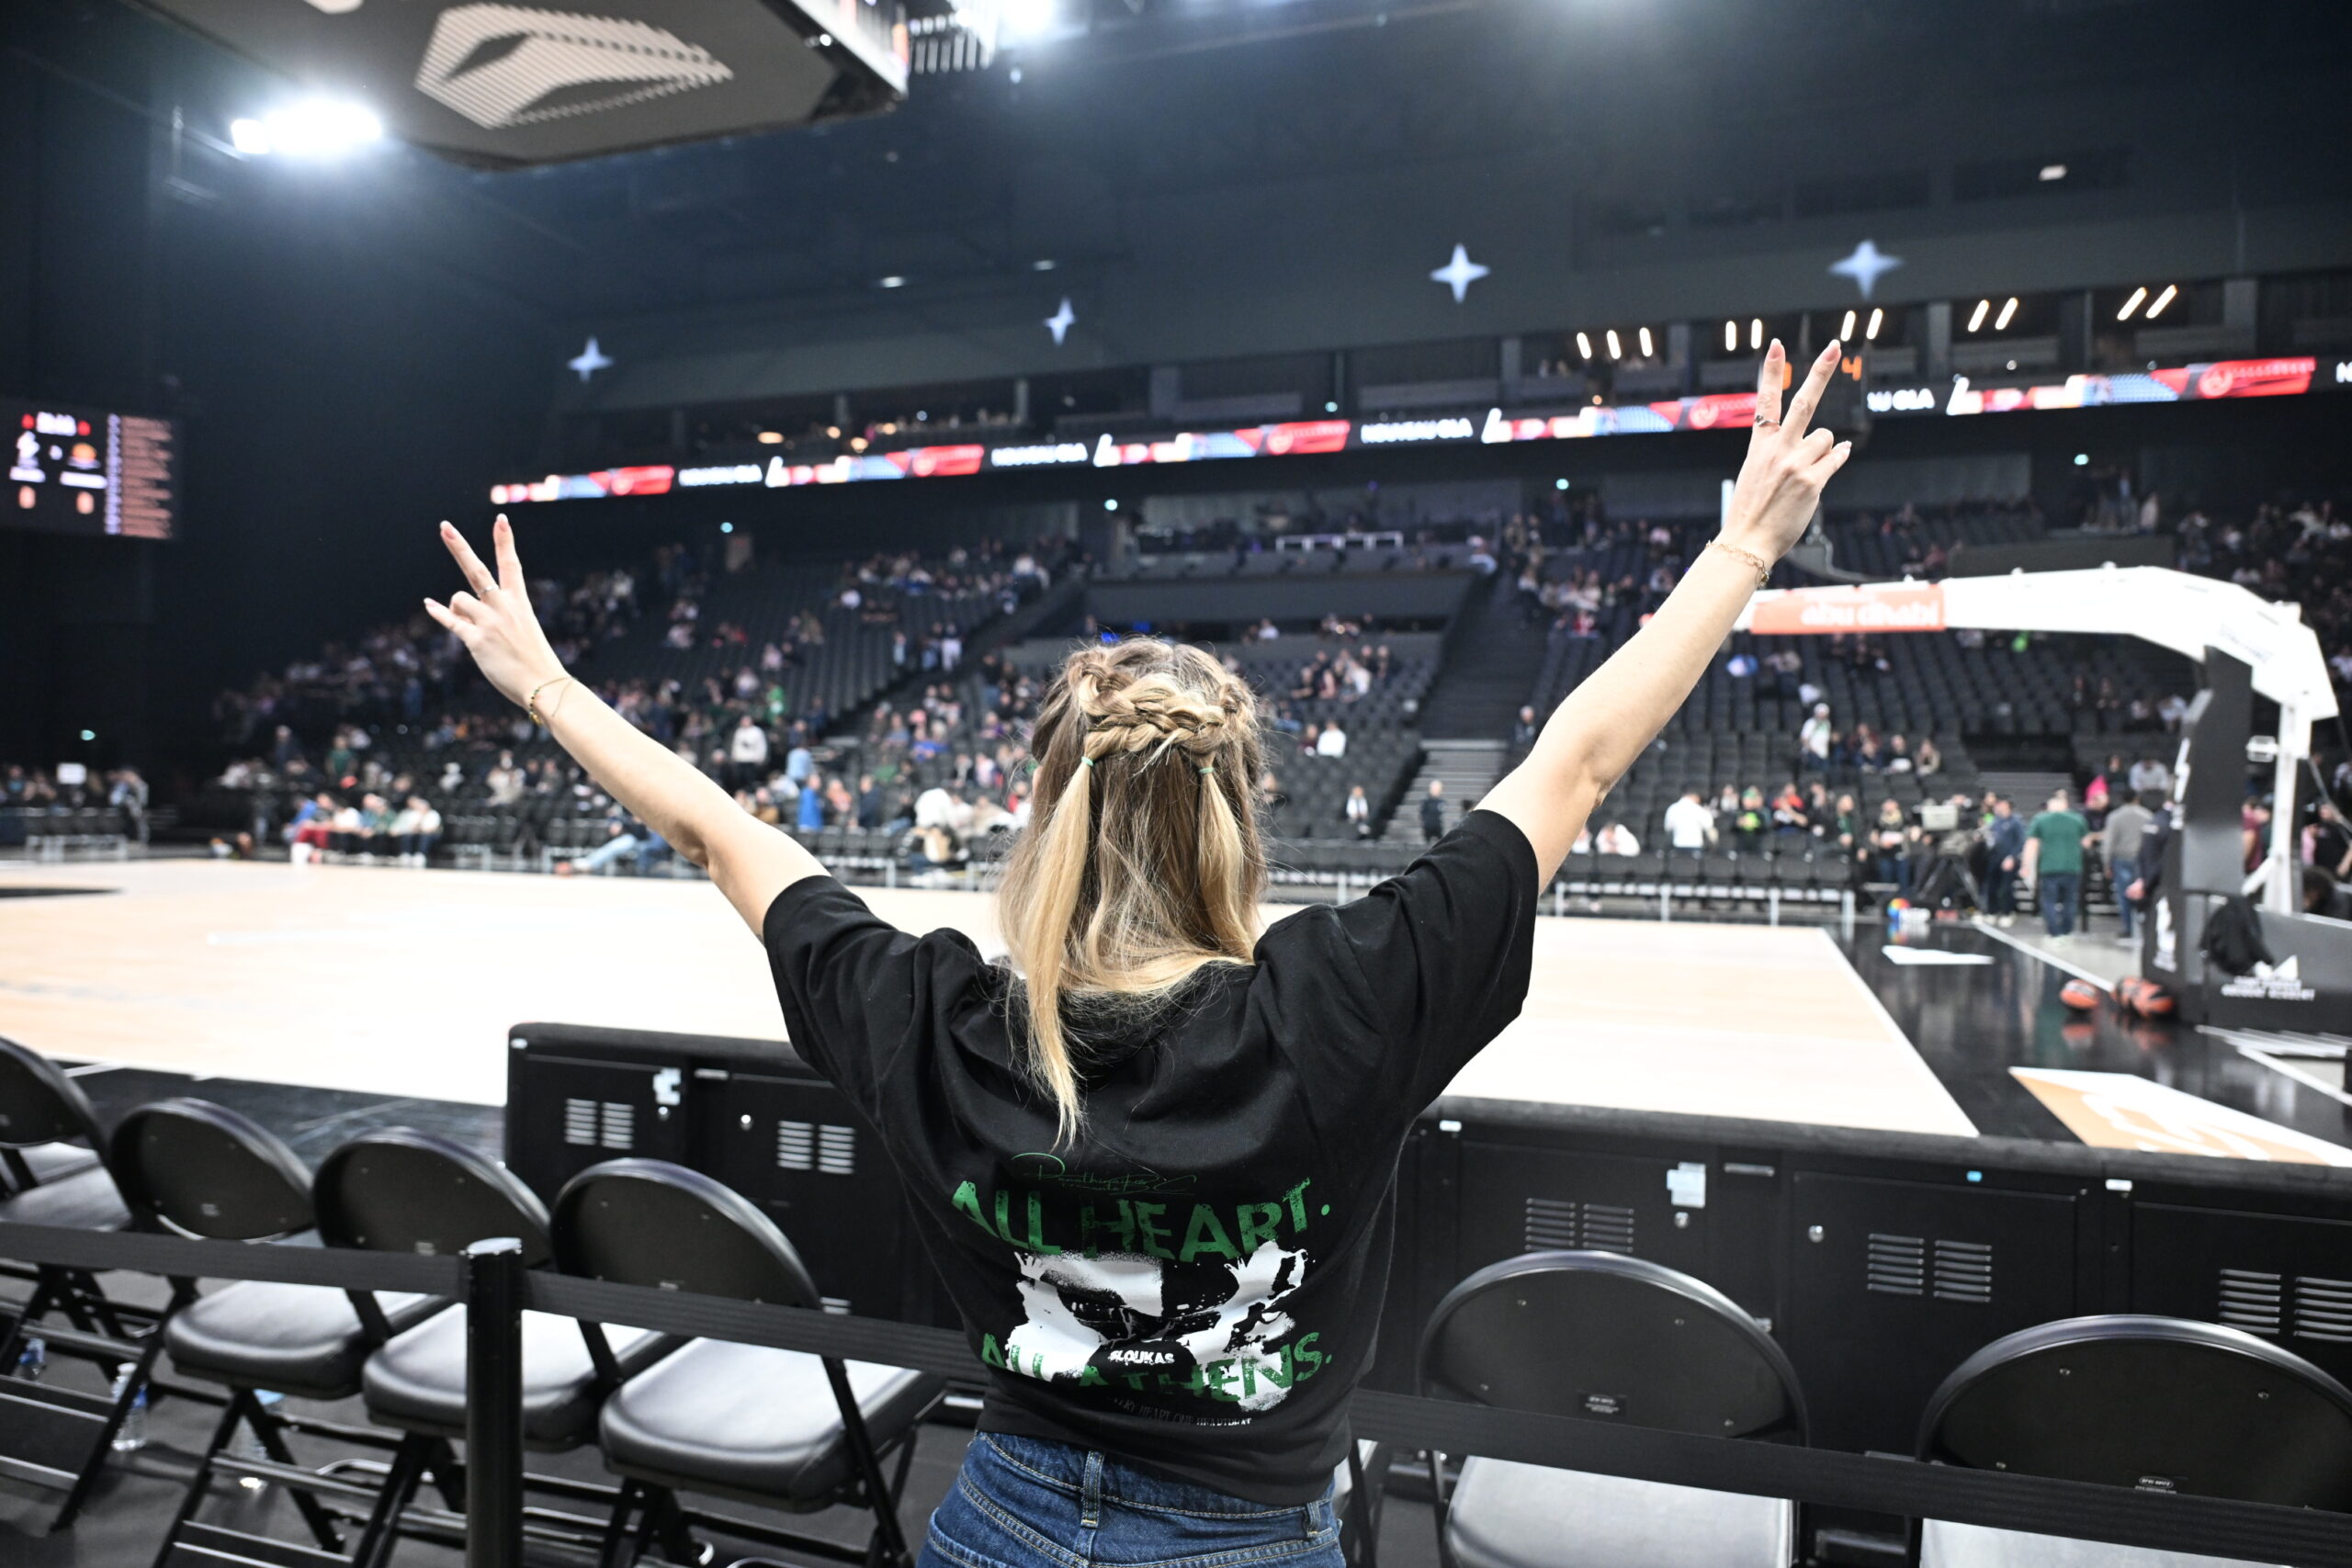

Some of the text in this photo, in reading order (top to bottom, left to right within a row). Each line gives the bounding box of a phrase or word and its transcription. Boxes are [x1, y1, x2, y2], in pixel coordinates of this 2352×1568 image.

[952, 1177, 1331, 1263] ALL HEART.
[1108, 1349, 1176, 1366] SLOUKAS
